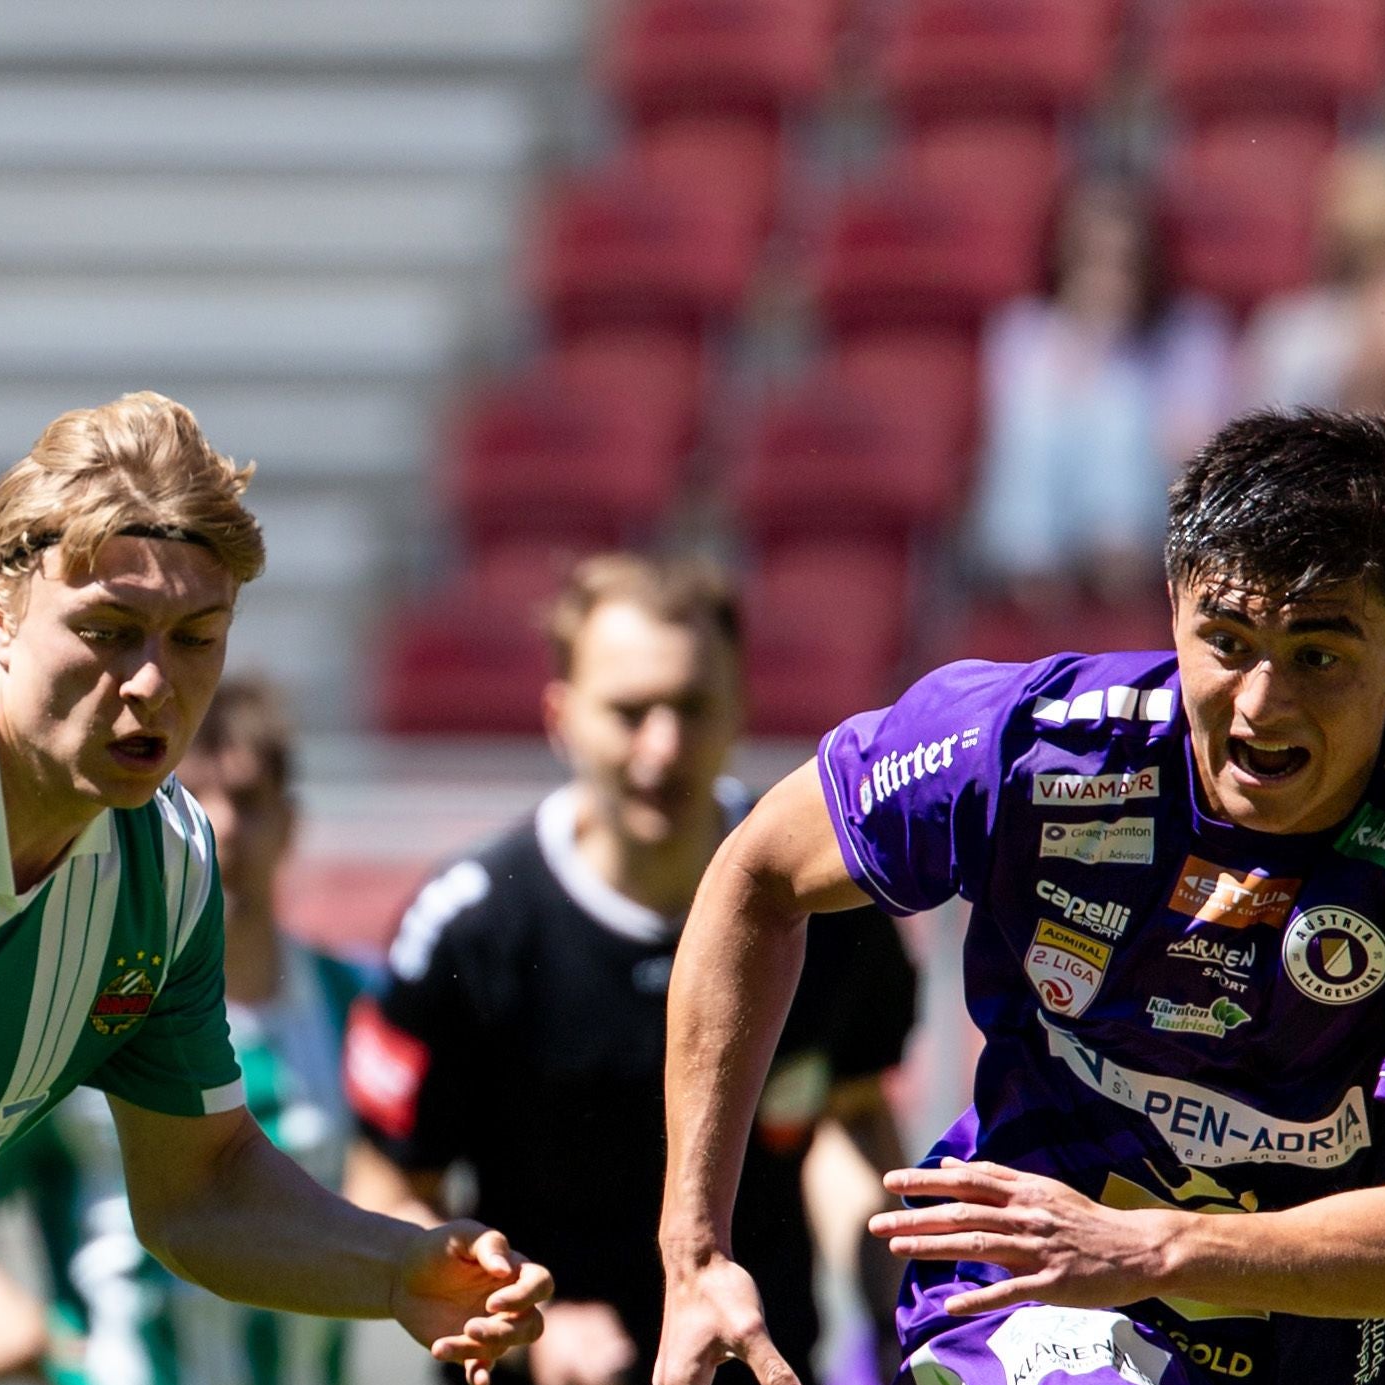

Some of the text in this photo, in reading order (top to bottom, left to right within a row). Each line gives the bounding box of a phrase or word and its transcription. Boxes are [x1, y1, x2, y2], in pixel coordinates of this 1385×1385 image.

[872, 733, 959, 803] Hirter
[1036, 879, 1132, 933] capelli
[1043, 927, 1103, 960] ADMIRAL
[1296, 913, 1374, 943] AUSTRIA
[1032, 950, 1095, 987] 2. LIGA
[1202, 966, 1249, 993] SPORT
[1298, 967, 1382, 999] KLAGENFURT
[1149, 999, 1211, 1019] Kärnten
[1154, 1013, 1225, 1035] Taufrisch
[1143, 1089, 1361, 1153] PEN-ADRIA
